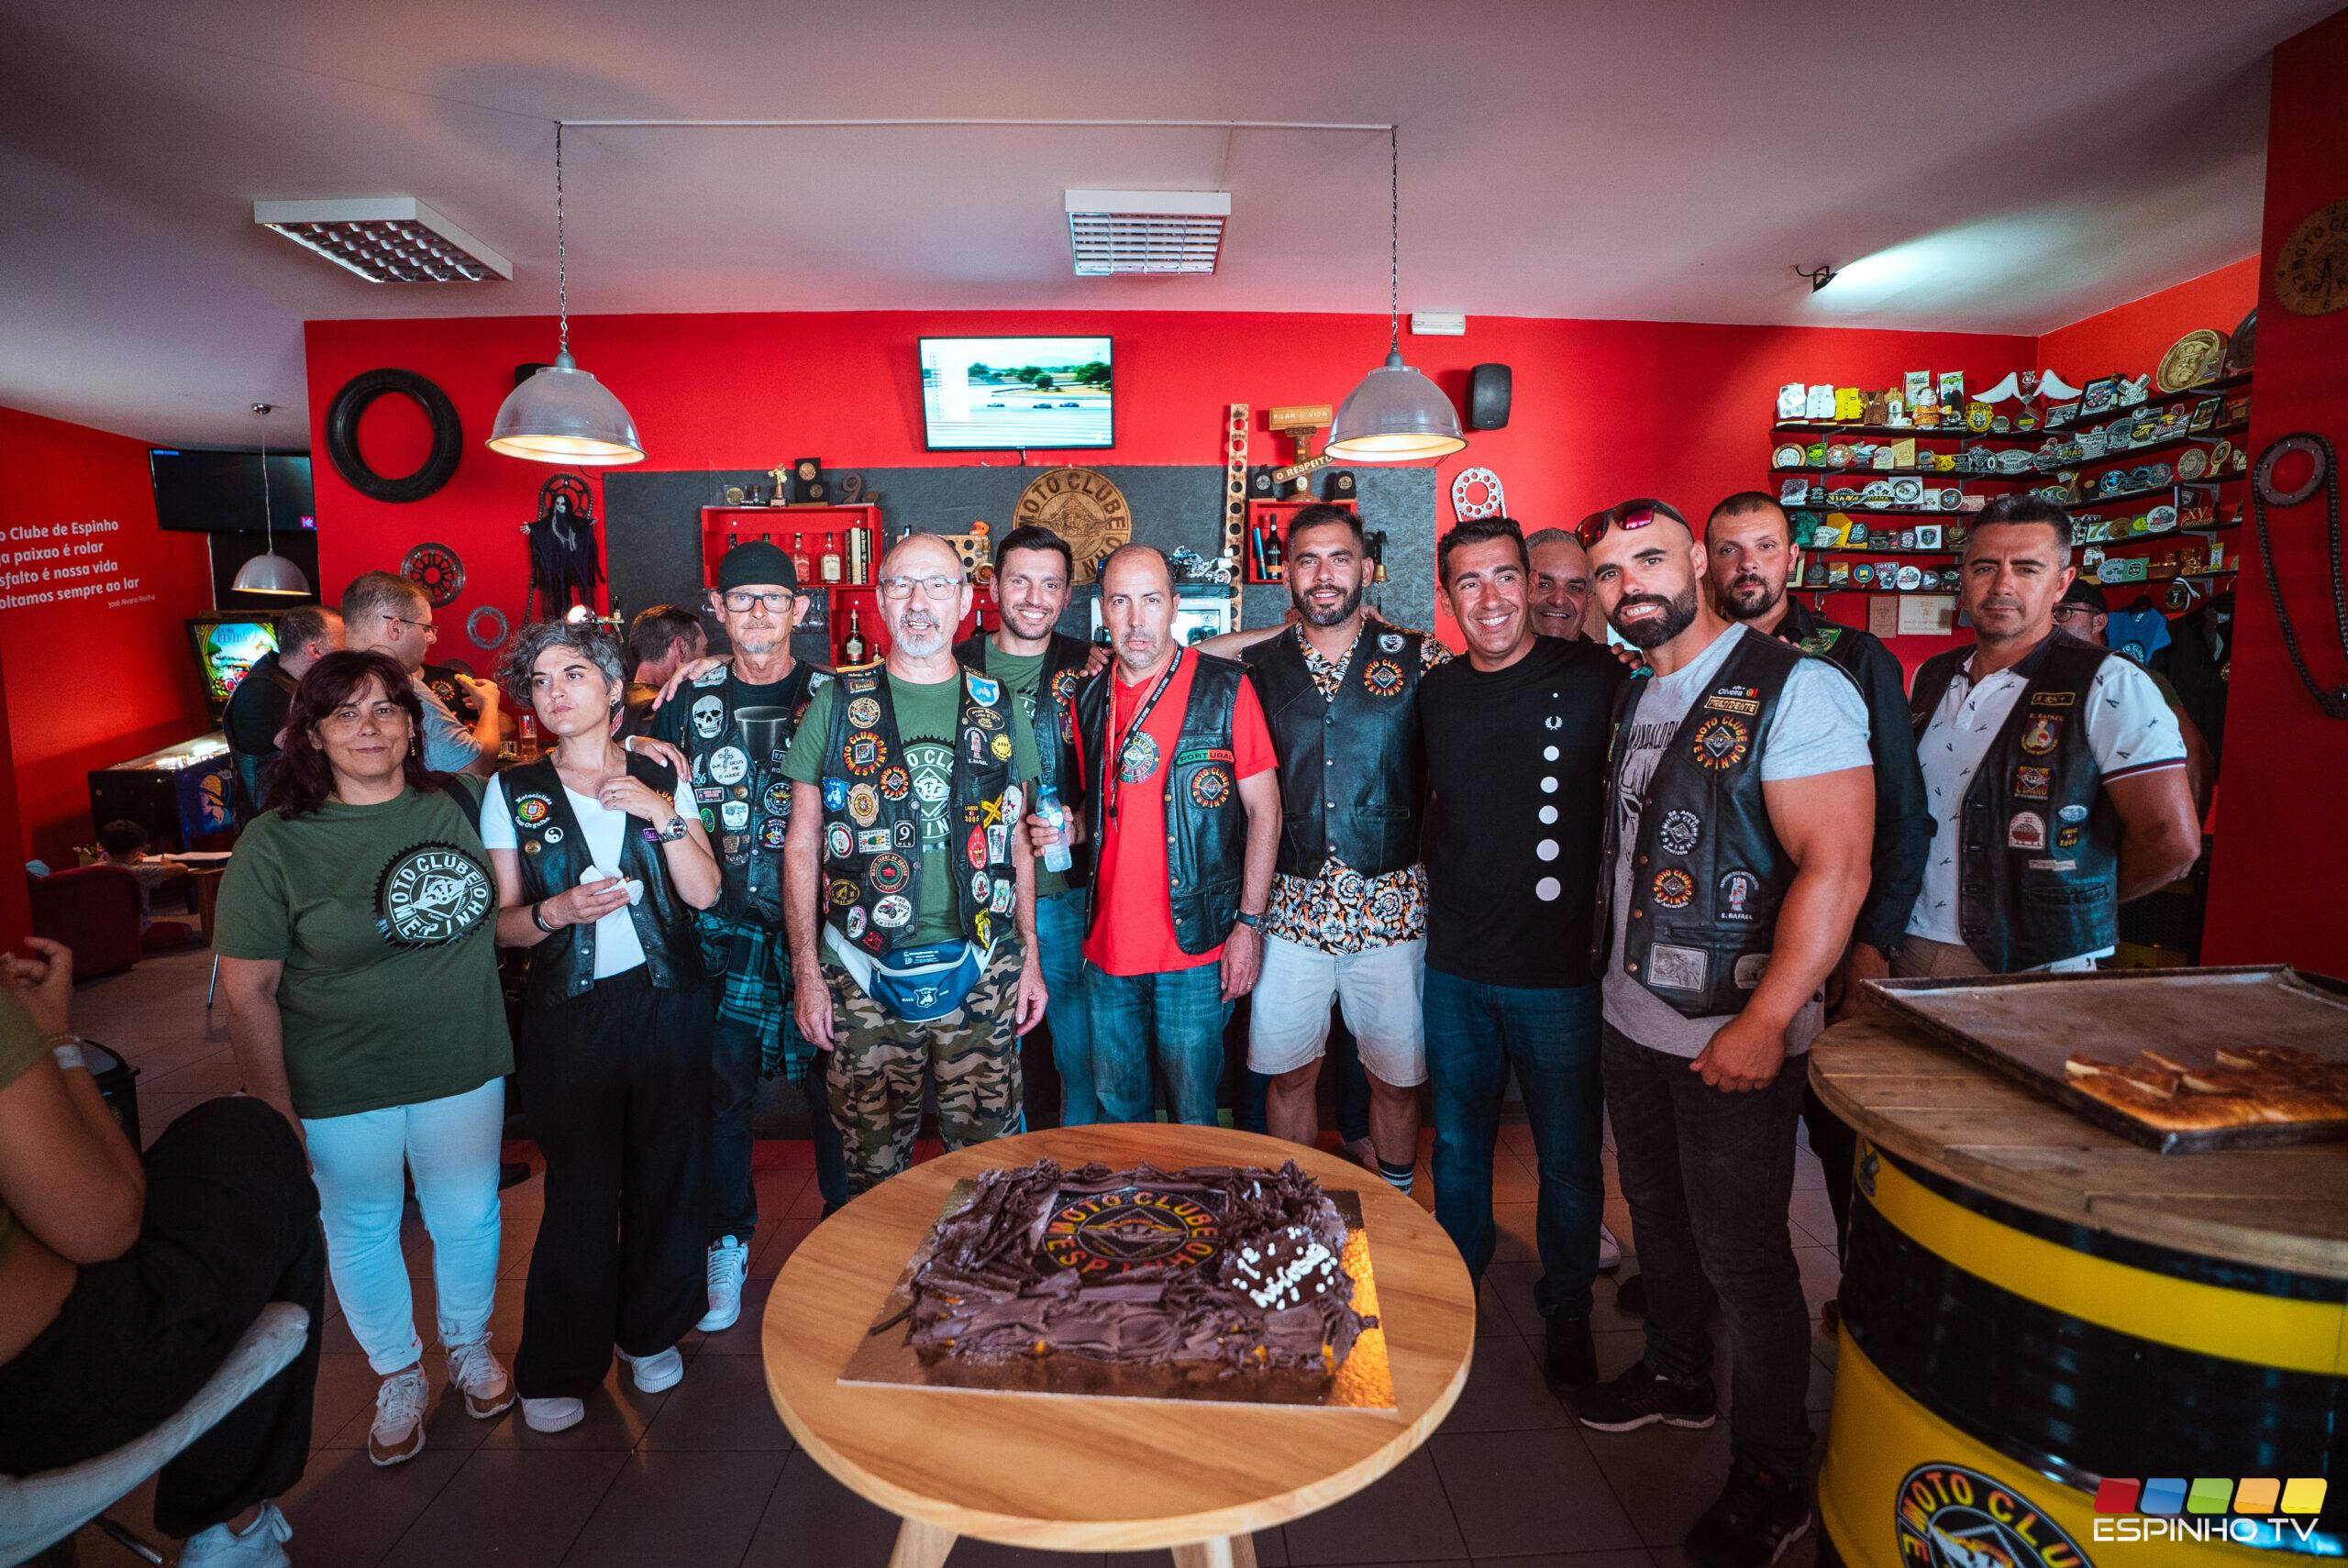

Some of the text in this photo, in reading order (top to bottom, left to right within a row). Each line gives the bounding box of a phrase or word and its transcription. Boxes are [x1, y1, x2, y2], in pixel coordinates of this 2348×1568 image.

[1286, 457, 1333, 477] RESPEITO
[1068, 472, 1125, 528] CLUBE
[10, 526, 49, 540] Clube
[52, 524, 68, 536] de
[72, 519, 119, 537] Espinho
[62, 544, 71, 557] é
[73, 541, 104, 556] rolar
[42, 568, 50, 580] é
[53, 565, 90, 580] nossa
[93, 559, 118, 573] vida
[57, 583, 103, 601] sempre
[105, 582, 121, 593] ao
[123, 577, 139, 590] lar
[1364, 659, 1404, 679] MOTO CLUBE
[1052, 671, 1065, 690] MOTO
[1364, 679, 1404, 697] ESPINHO
[1708, 699, 1756, 712] PRESIDENTE
[1695, 718, 1718, 742] MOTO
[1722, 715, 1747, 742] CLUBE
[844, 732, 879, 771] MOTO CLUBE
[855, 740, 887, 776] ESPINHO
[1180, 752, 1233, 763] PORTUGAL
[1693, 744, 1746, 769] ESPINHO
[1192, 767, 1230, 789] MOTO CLUBE
[1193, 789, 1229, 808] ESPINHO
[515, 815, 550, 830] Com Orgulho
[900, 826, 910, 841] 9
[392, 856, 481, 920] MOTO CLUBE
[1048, 1191, 1219, 1239] MOTO CLUBE
[1902, 1471, 1975, 1529] MOTO
[1988, 1490, 2080, 1568] CLU
